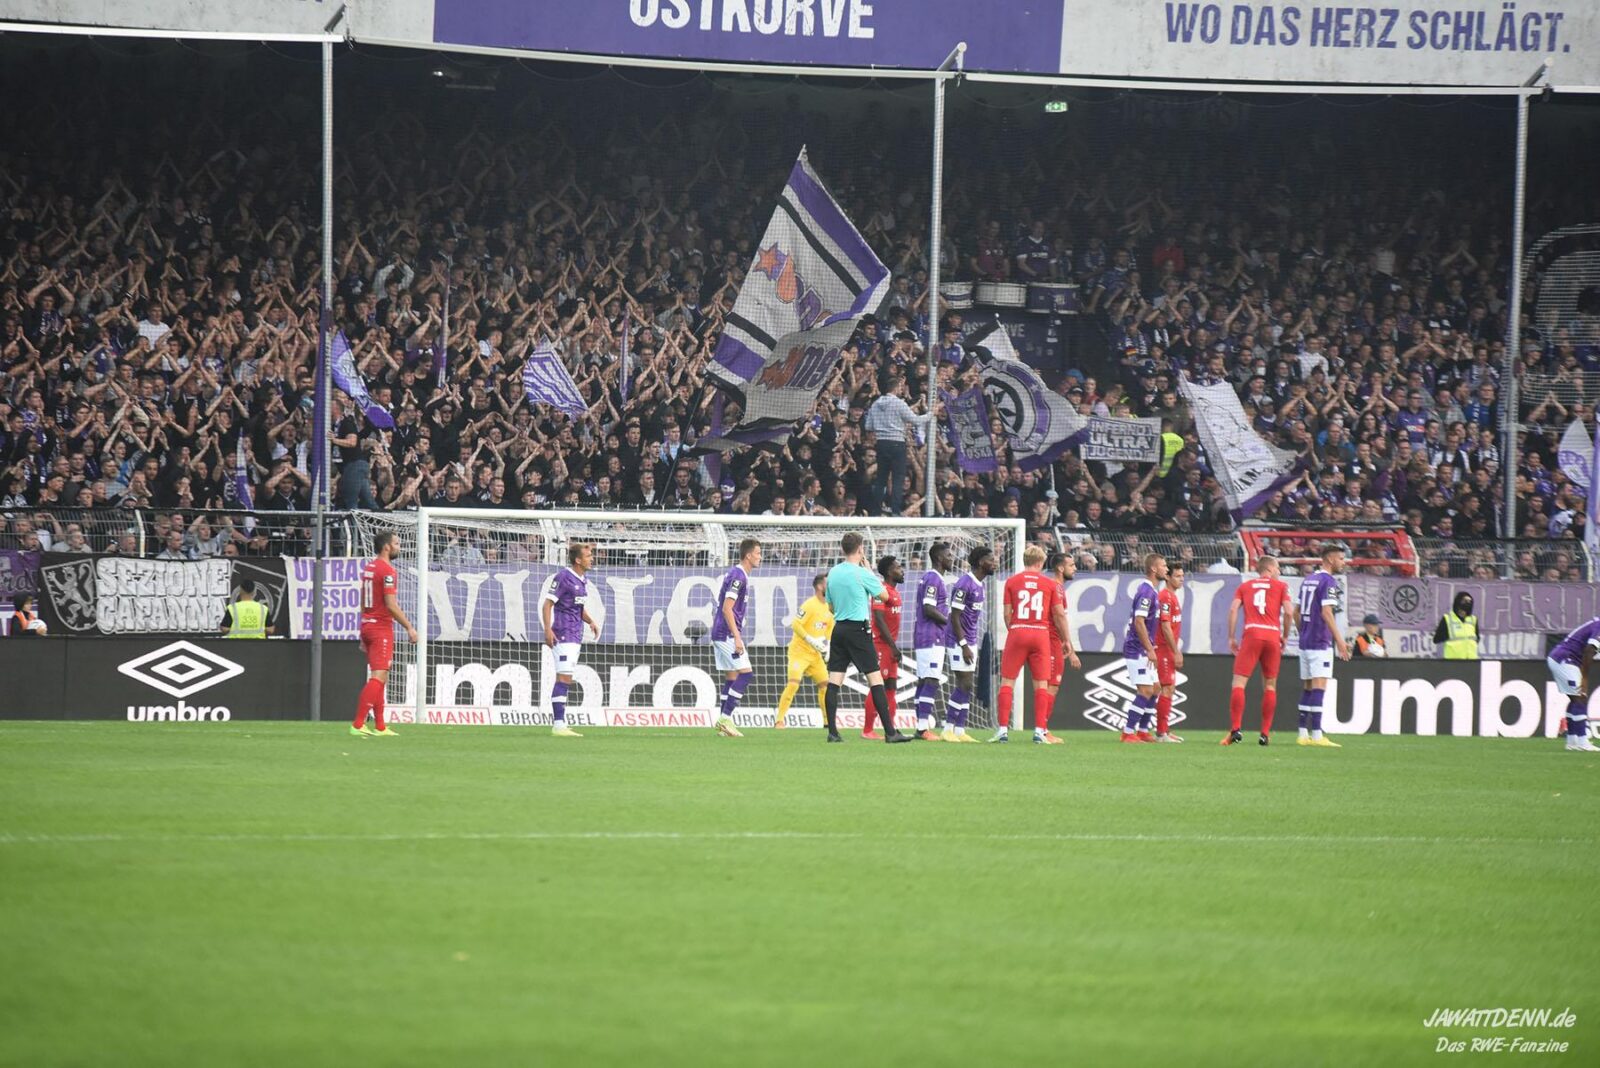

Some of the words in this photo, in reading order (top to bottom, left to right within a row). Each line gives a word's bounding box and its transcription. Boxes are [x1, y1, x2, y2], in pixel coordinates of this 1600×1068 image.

[1165, 2, 1221, 44] WO
[1230, 5, 1301, 46] DAS
[1310, 8, 1399, 49] HERZ
[1406, 2, 1570, 53] SCHLÄGT.
[1090, 431, 1151, 449] ULTRA
[1090, 446, 1144, 460] JUGEND
[97, 557, 231, 598] SEZIONE
[364, 579, 373, 608] 11
[1017, 590, 1044, 620] 24
[1253, 588, 1267, 615] 4
[1300, 585, 1317, 615] 17
[1434, 582, 1598, 631] INFERN
[97, 597, 226, 634] CAPANNA
[303, 611, 361, 631] BFOR
[127, 701, 231, 722] umbro
[1321, 660, 1600, 738] umbr
[390, 710, 485, 725] ASMANN
[500, 709, 597, 726] BÜROMBEL
[613, 712, 706, 726] ASSMANN
[732, 710, 816, 728] ÜROMBEL
